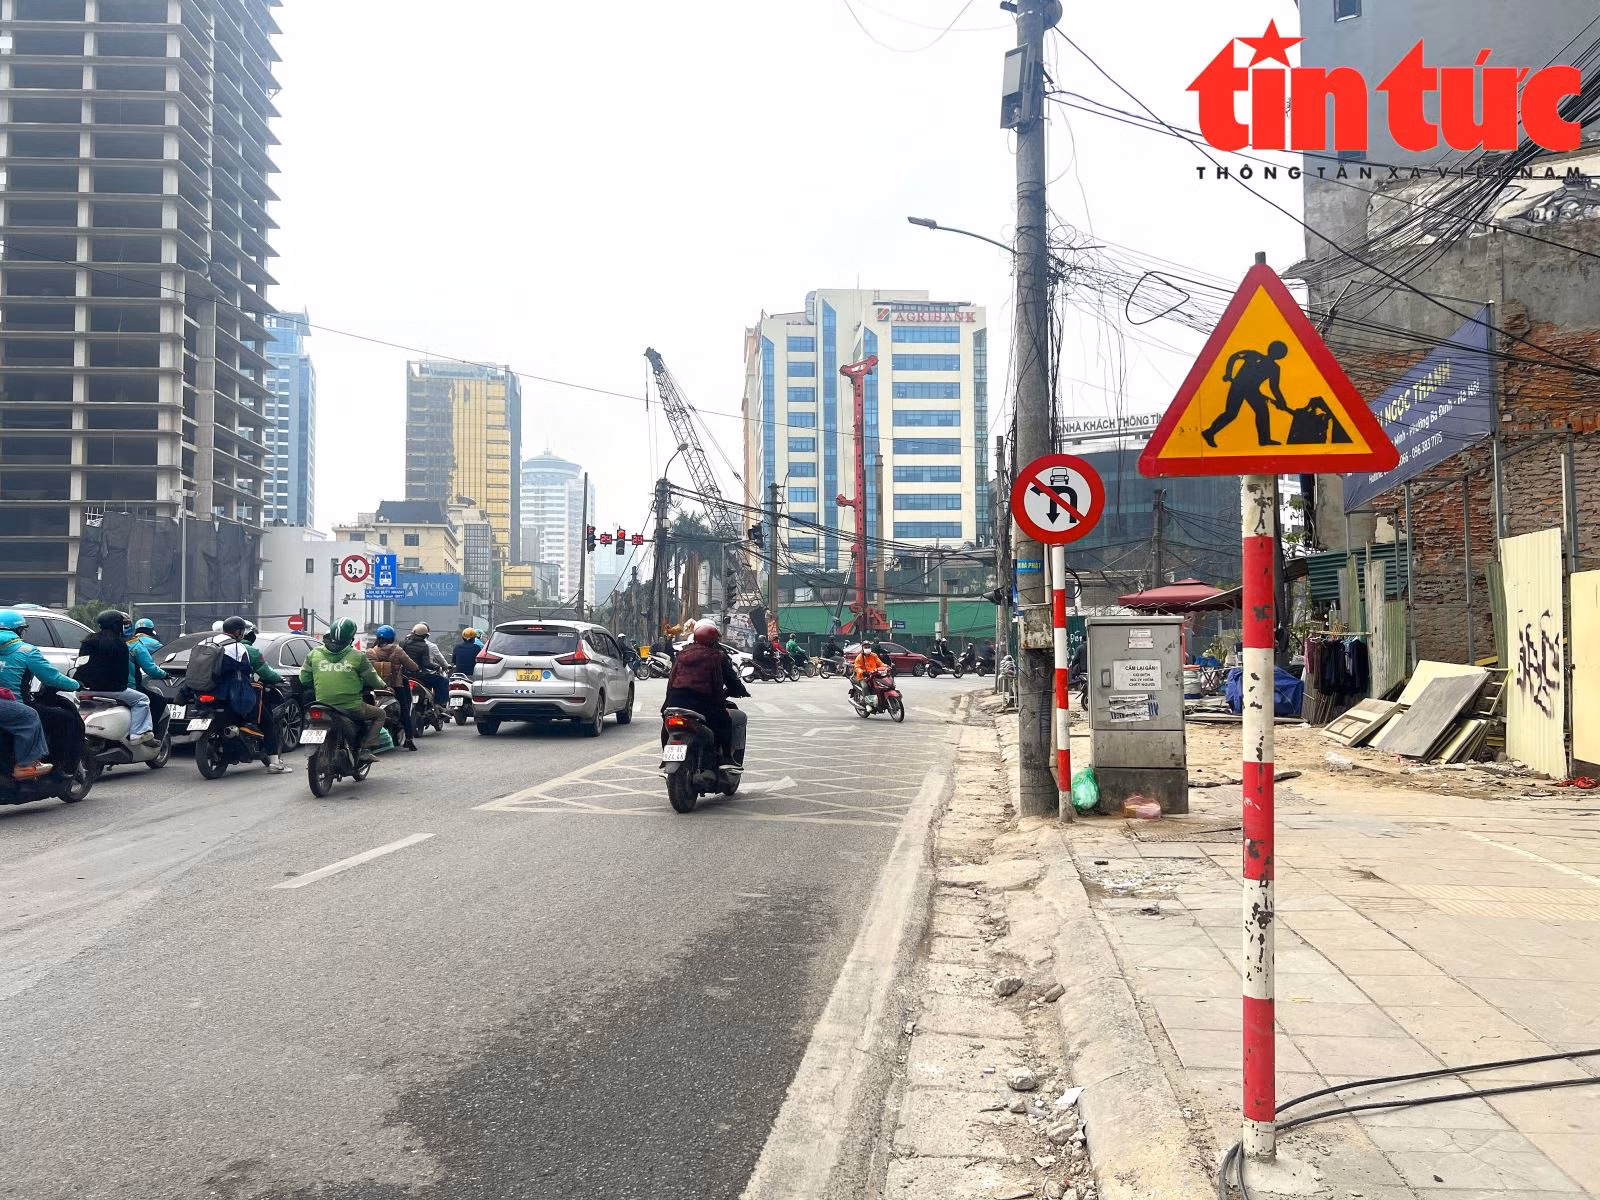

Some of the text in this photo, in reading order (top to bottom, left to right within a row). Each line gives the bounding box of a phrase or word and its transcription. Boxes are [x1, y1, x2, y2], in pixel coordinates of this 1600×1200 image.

[895, 311, 976, 322] AGRIBANK
[1063, 421, 1081, 433] NHÀ
[1083, 417, 1116, 431] KHÁCH
[1117, 415, 1149, 428] THÔNG
[420, 582, 453, 590] APOLLO
[319, 660, 352, 672] Grab
